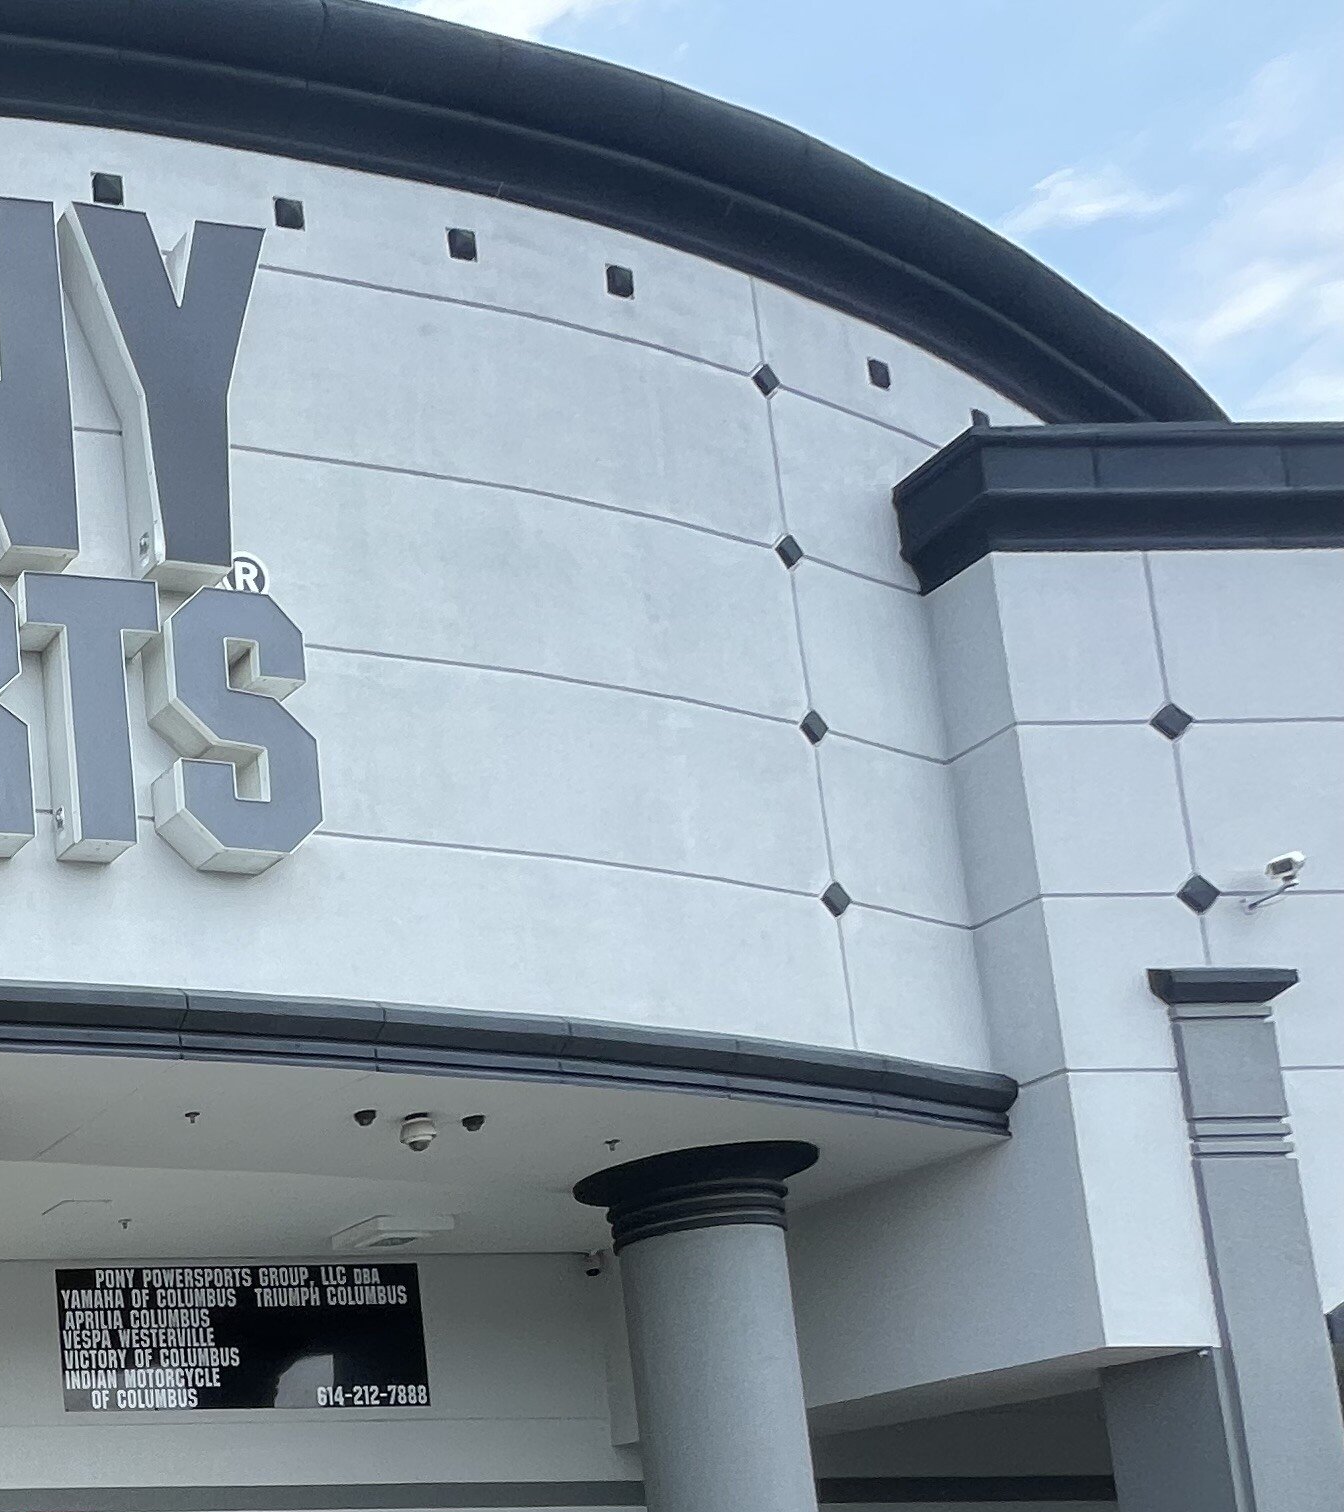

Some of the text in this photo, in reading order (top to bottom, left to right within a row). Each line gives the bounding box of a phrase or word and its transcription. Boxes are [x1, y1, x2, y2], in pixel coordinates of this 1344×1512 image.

[94, 1268, 135, 1289] PONY
[142, 1266, 252, 1289] POWERSPORTS
[320, 1265, 347, 1286] LLC
[353, 1267, 381, 1285] DBA
[61, 1287, 238, 1310] YAMAHA OF COLUMBUS
[253, 1284, 408, 1308] TRIUMPH COLUMBUS
[64, 1308, 211, 1331] APRILIA COLUMBUS
[62, 1327, 216, 1350] VESPA WESTERVILLE
[63, 1346, 241, 1370] VICTORY OF COLUMBUS
[64, 1367, 222, 1390] INDIAN MOTORCYCLE
[91, 1387, 199, 1410] OF COLUMBUS
[316, 1384, 428, 1407] 614-212-7888
